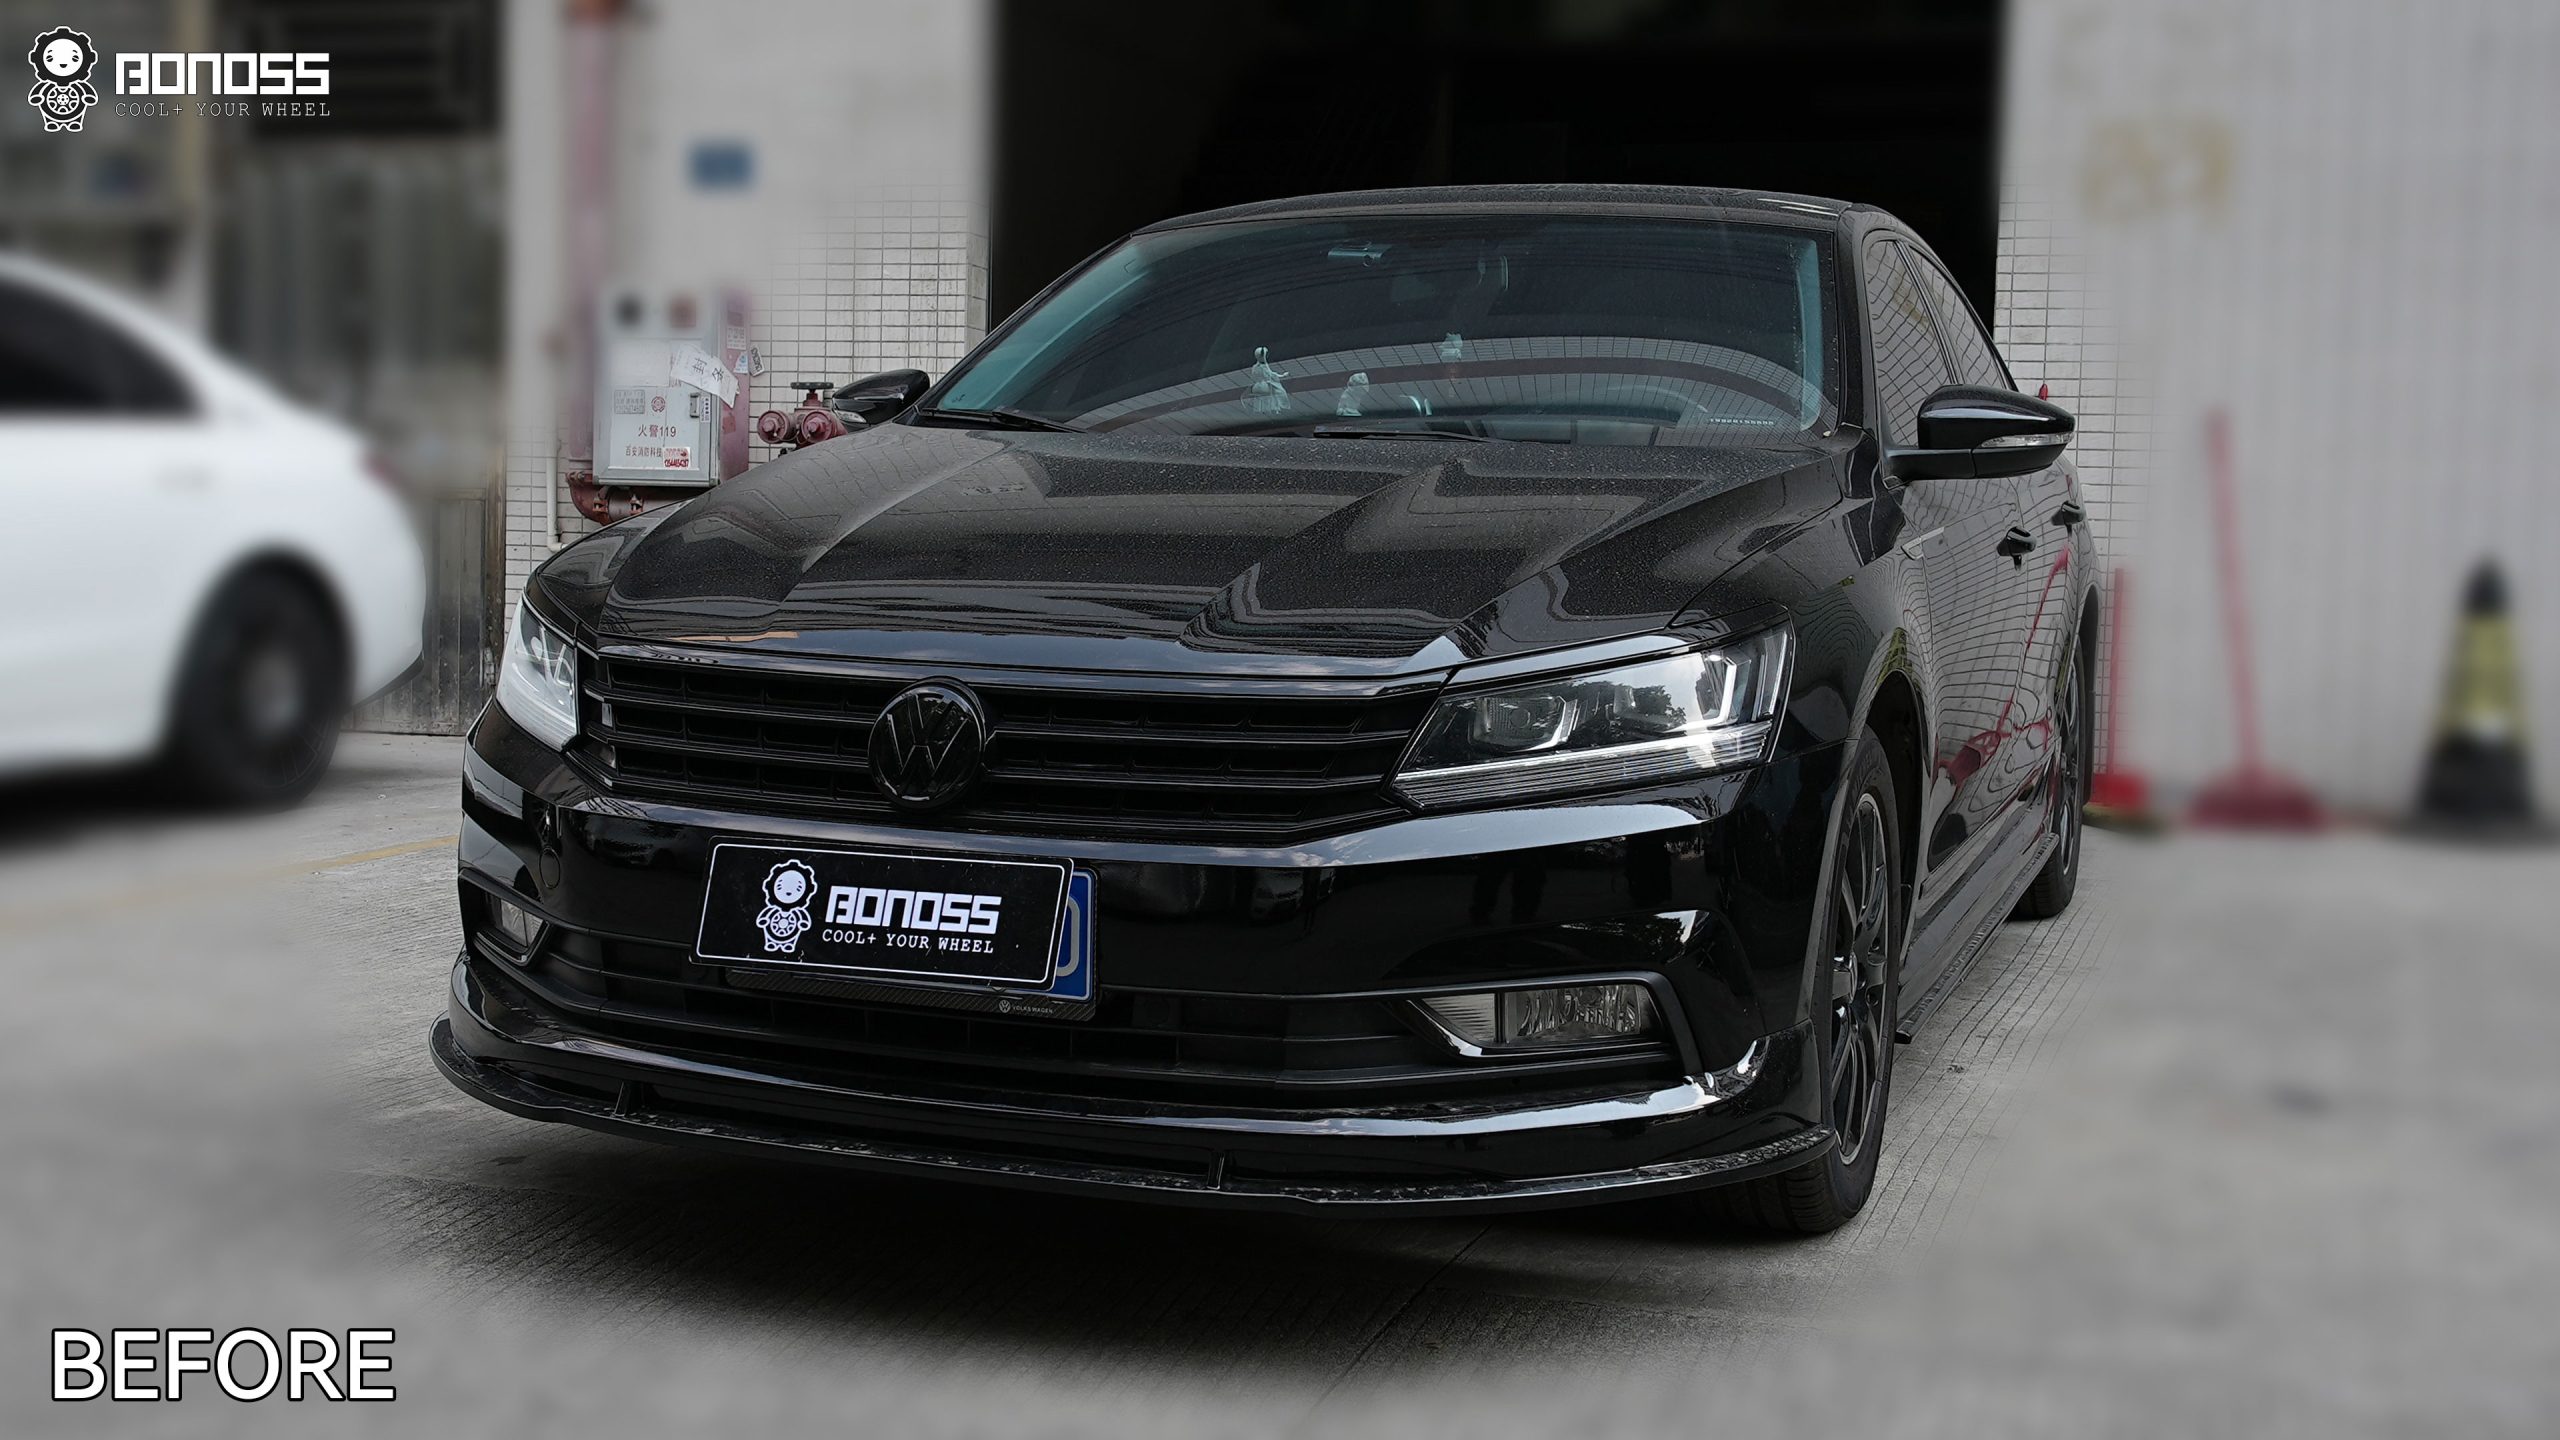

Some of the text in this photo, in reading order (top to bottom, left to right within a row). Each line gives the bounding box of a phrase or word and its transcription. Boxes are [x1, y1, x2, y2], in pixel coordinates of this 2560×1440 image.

[824, 885, 1002, 934] BONOSS
[822, 928, 994, 954] COOL+ YOUR WHEEL
